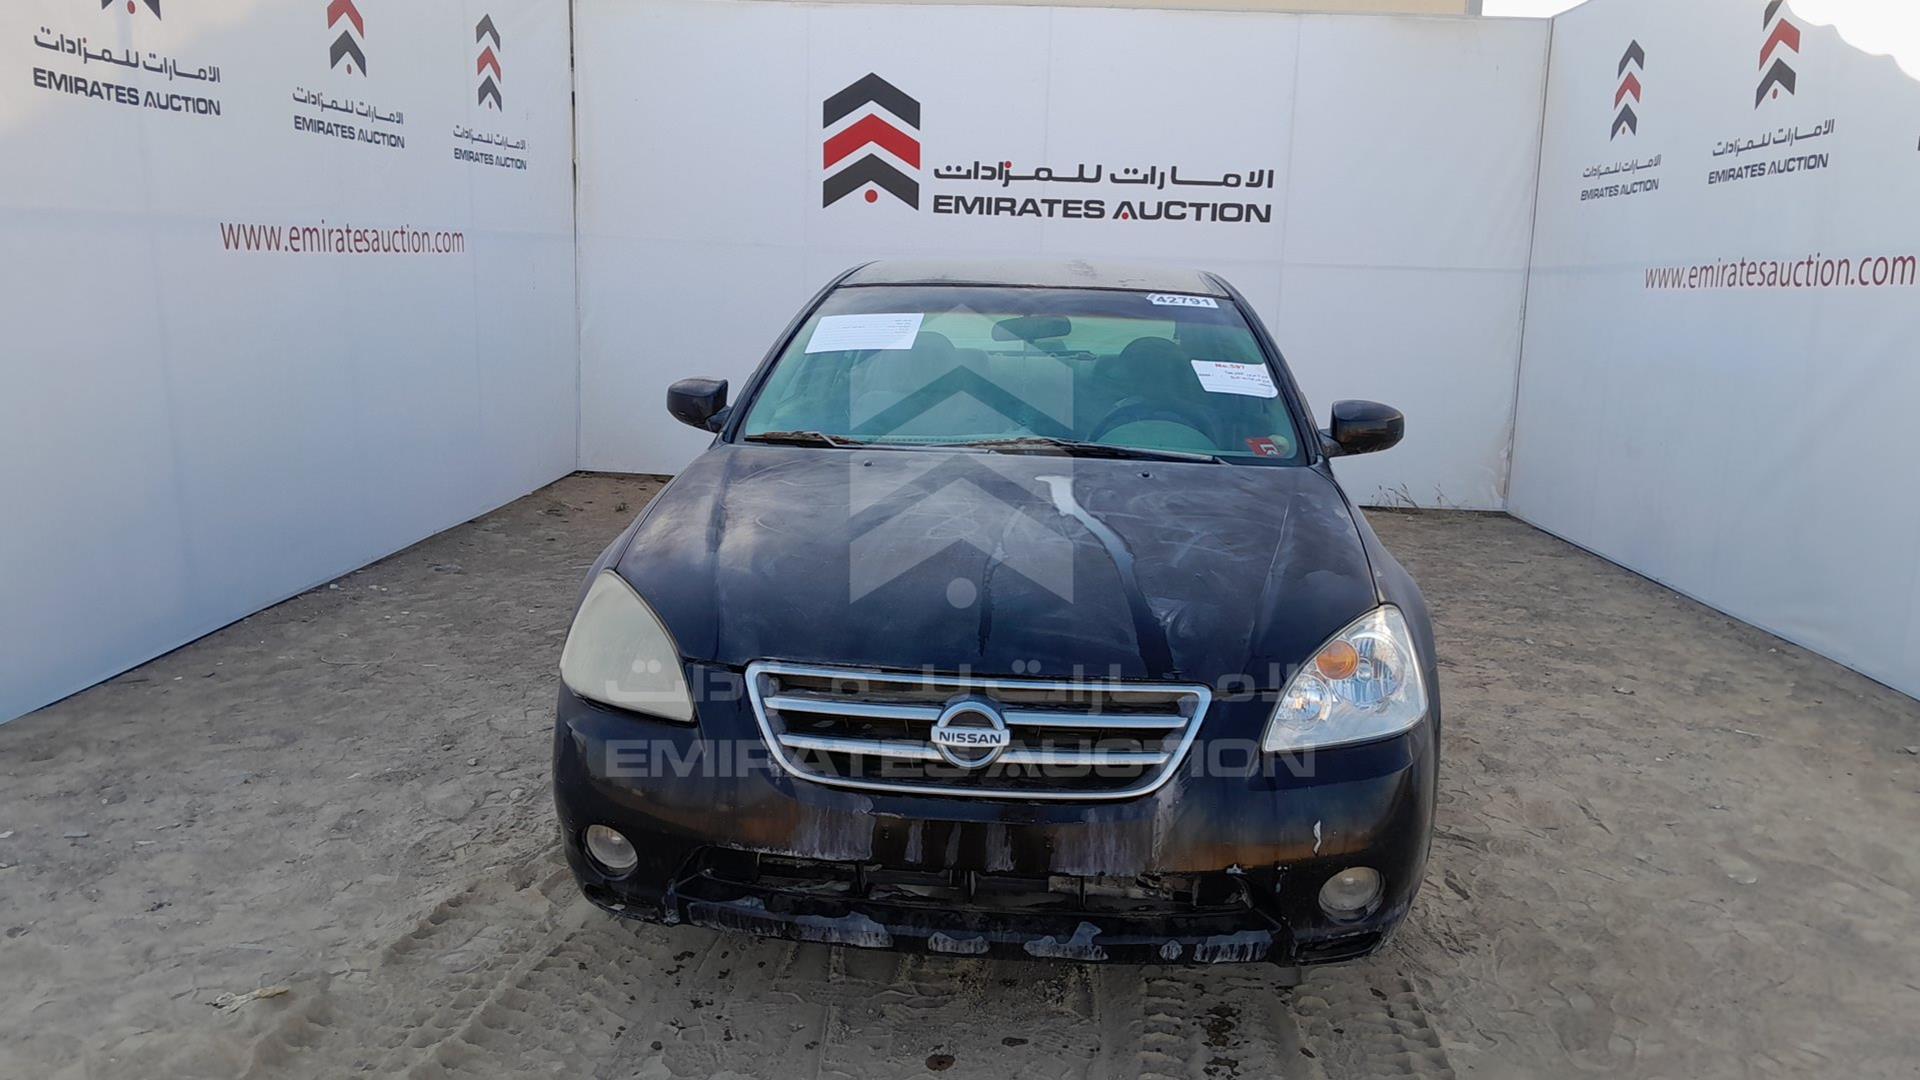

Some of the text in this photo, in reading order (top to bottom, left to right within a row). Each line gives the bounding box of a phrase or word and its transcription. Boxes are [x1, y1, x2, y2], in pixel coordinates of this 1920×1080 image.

[33, 67, 221, 116] EMIRATES AUCTION
[294, 115, 405, 149] EMIRATES AUCTION
[454, 147, 527, 170] EMIRATES AUCTION
[1708, 153, 1829, 185] EMIRATES AUCTION
[1580, 178, 1660, 201] EMIRATES AUCTION
[933, 194, 1272, 223] EMIRATES AUCTION
[220, 219, 465, 253] www.emiratesauction.com
[1645, 252, 1917, 289] www.emiratesauction.com
[939, 731, 1002, 744] NISSAN
